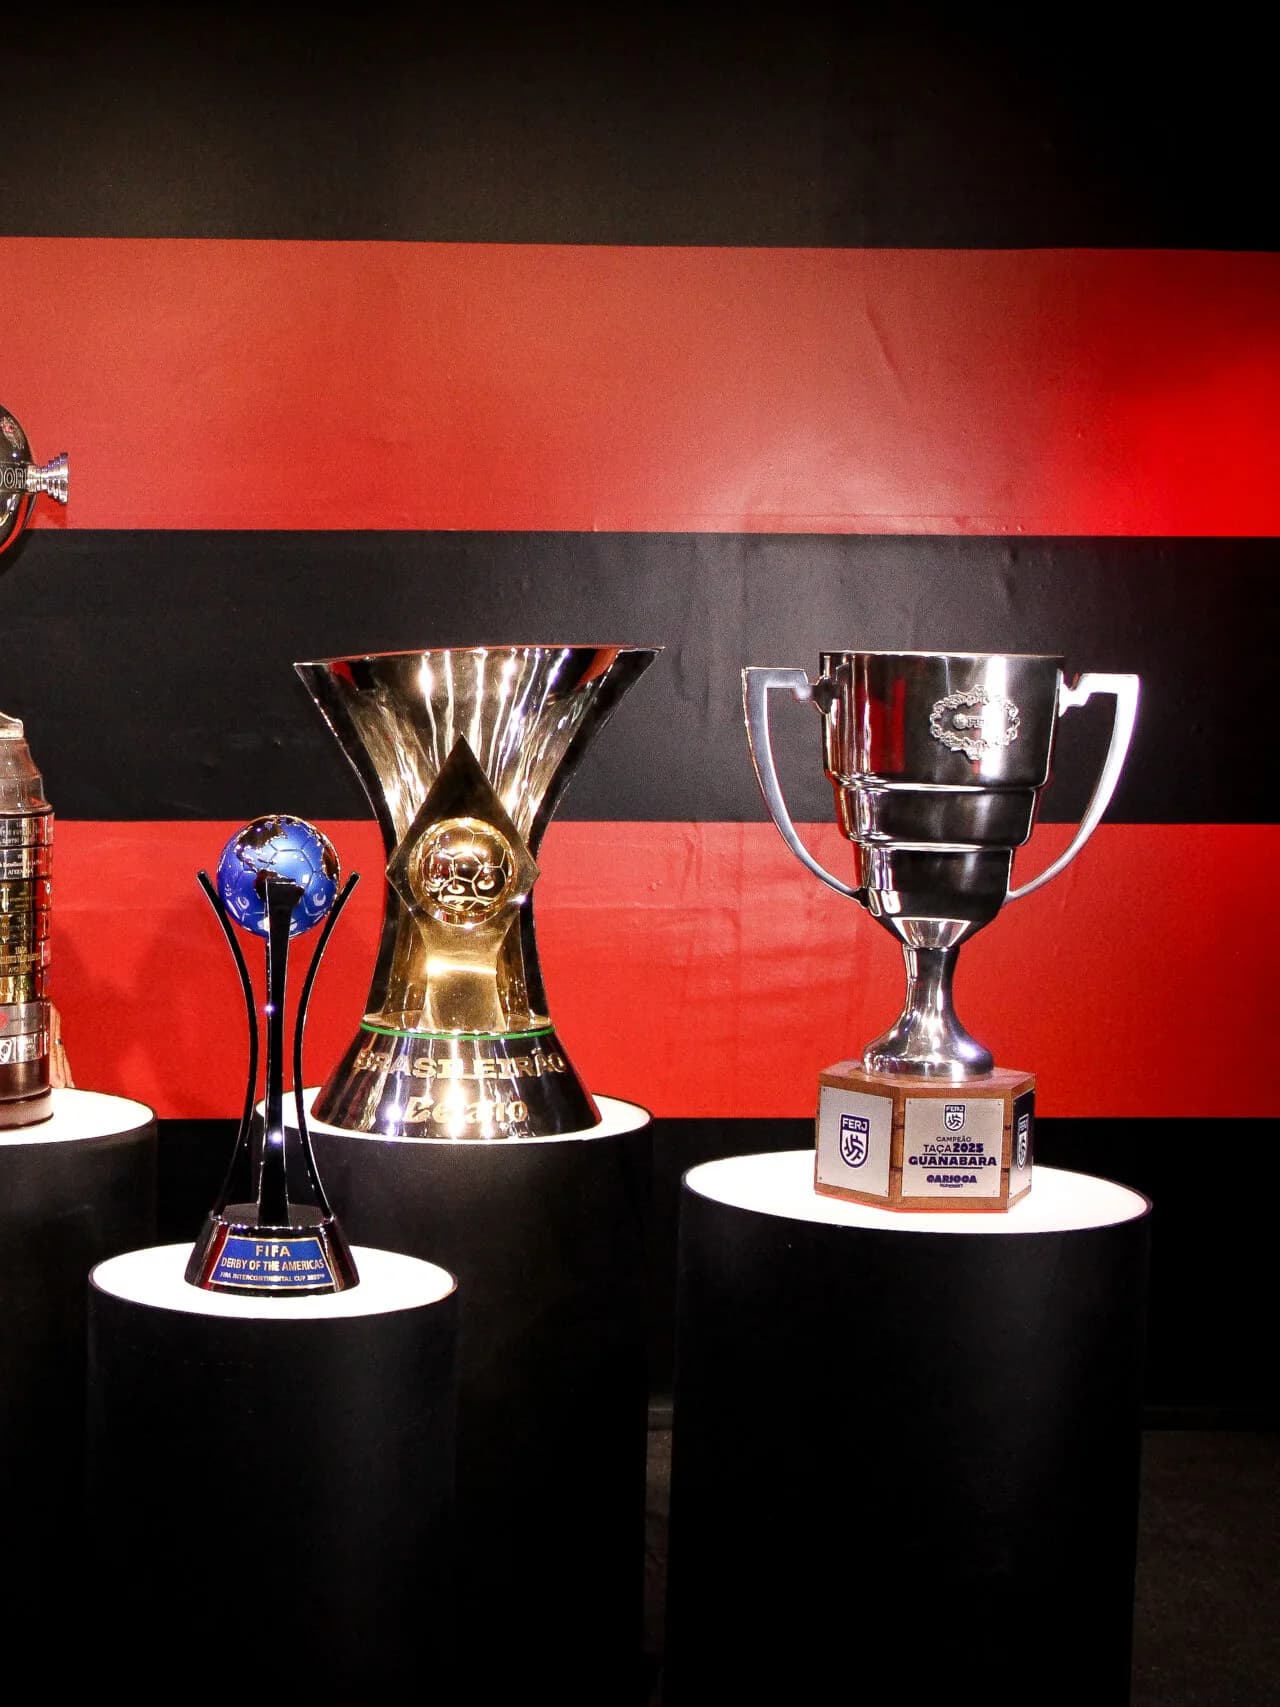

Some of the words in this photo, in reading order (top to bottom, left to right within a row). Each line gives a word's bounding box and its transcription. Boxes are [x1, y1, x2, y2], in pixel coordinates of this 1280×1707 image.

[842, 1117, 868, 1132] FERJ
[936, 1135, 972, 1143] CAMPEÃO
[923, 1144, 952, 1154] TAÇA
[953, 1143, 984, 1153] 2025
[908, 1156, 997, 1166] GUANABARA
[926, 1175, 977, 1183] CARIOCA
[256, 1245, 290, 1257] FIFA
[221, 1257, 247, 1269] DERBY
[249, 1260, 261, 1270] OF
[263, 1260, 280, 1271] THE
[282, 1259, 325, 1271] AMERICAS
